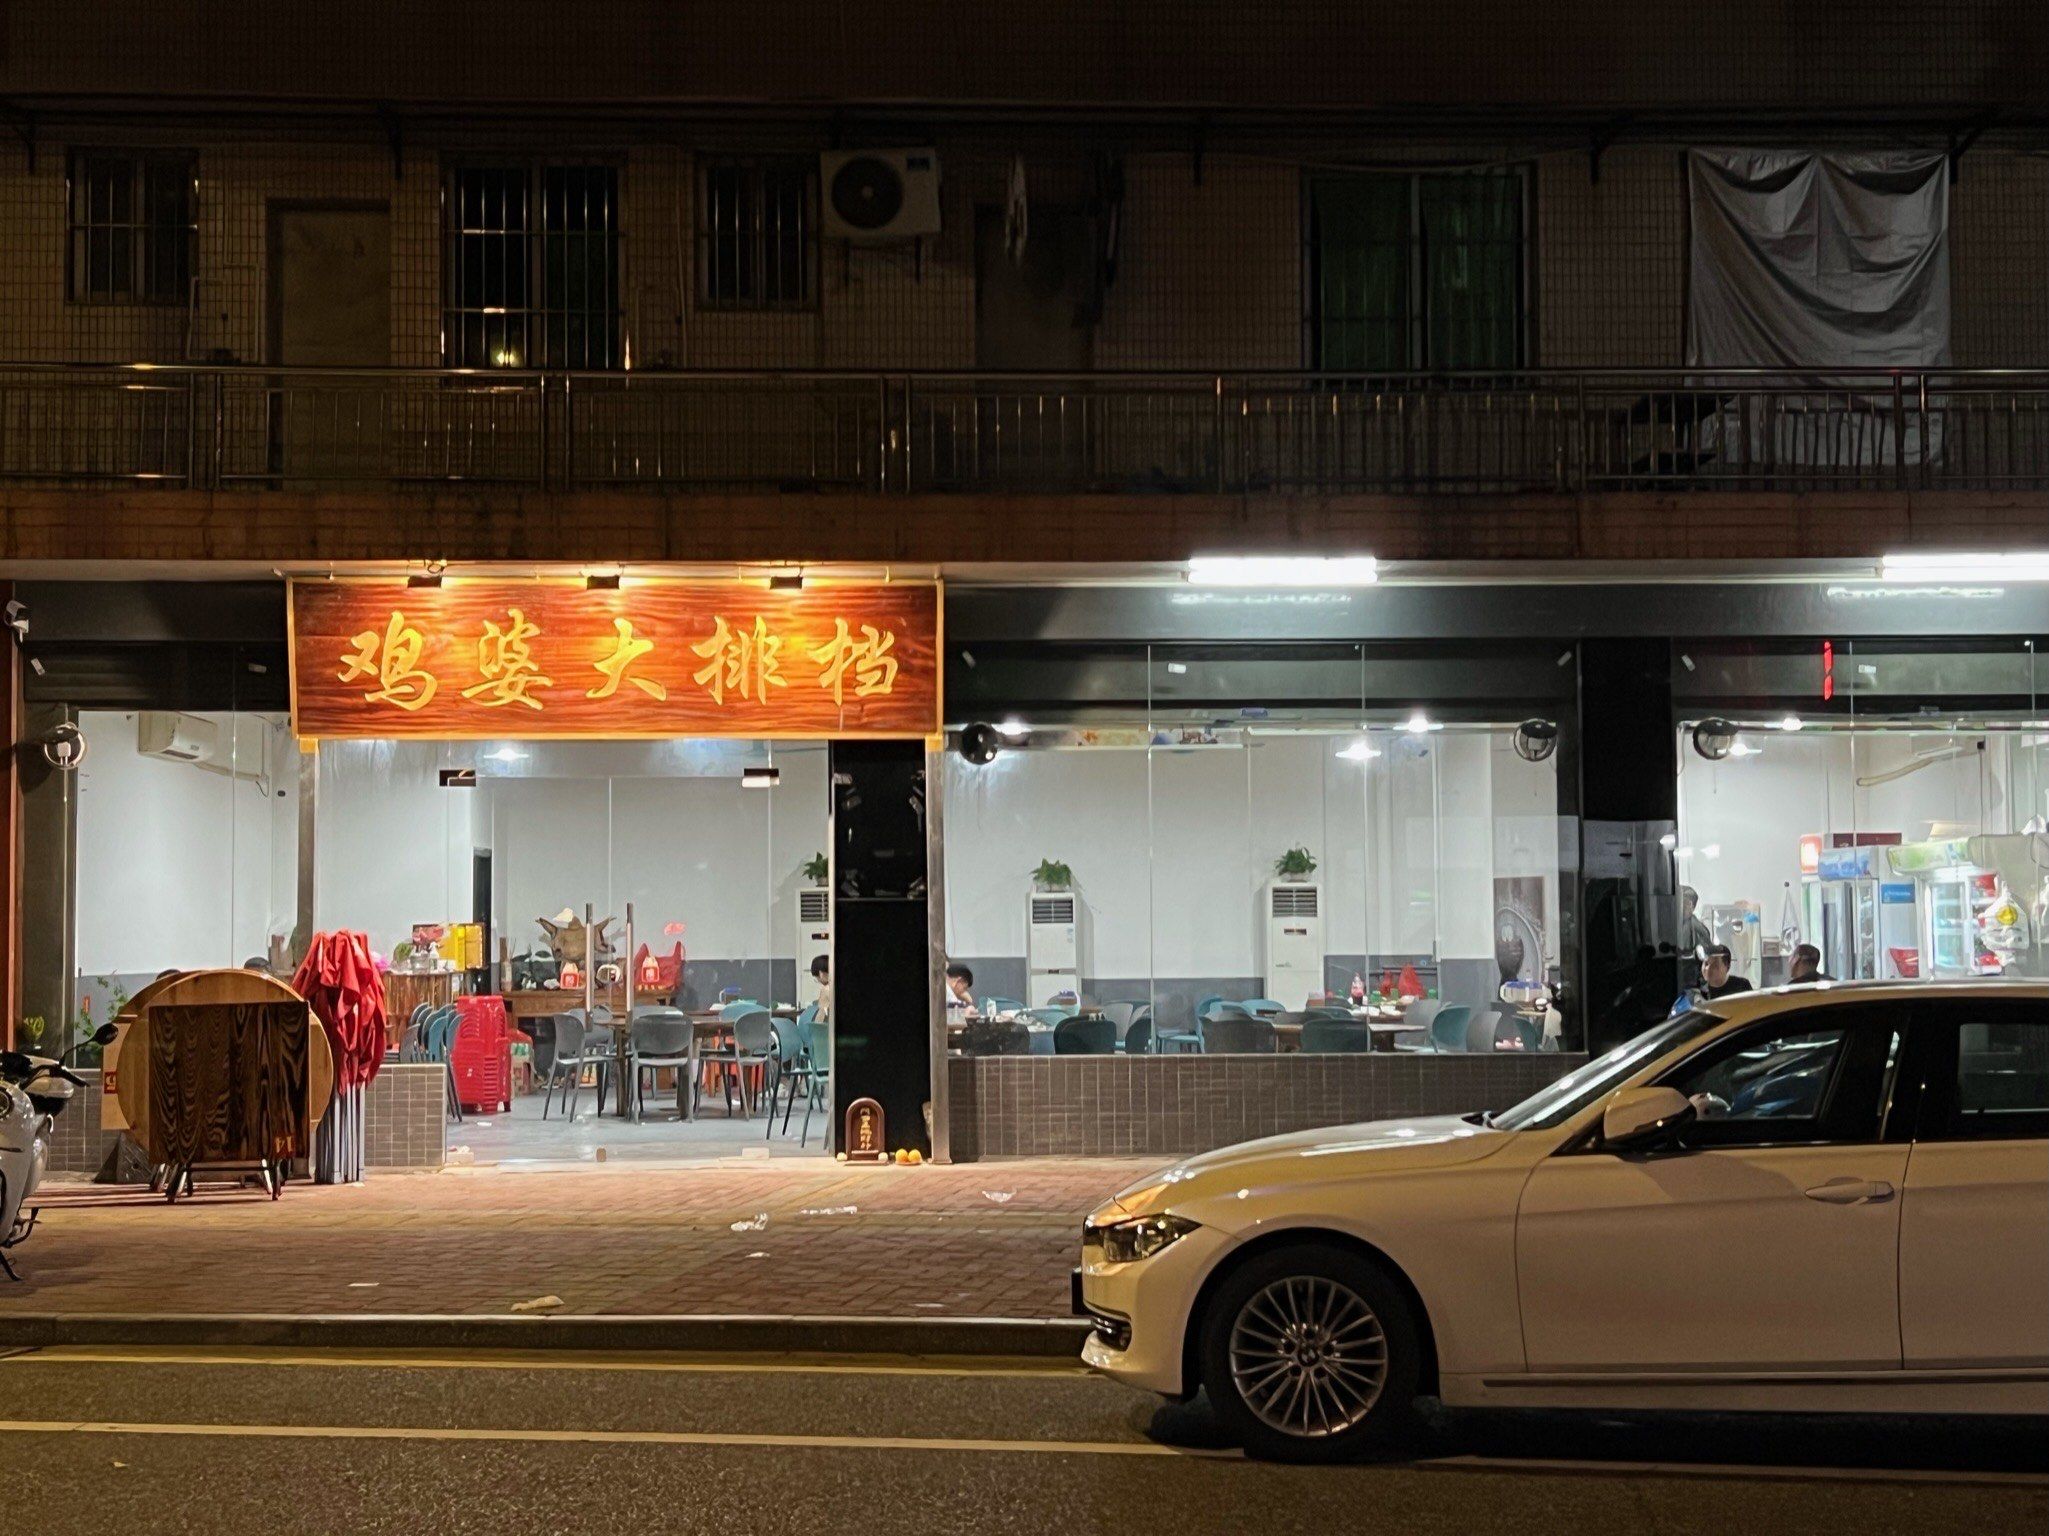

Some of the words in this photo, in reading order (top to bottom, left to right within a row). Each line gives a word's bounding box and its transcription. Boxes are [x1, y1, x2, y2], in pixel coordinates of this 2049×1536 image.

[337, 608, 899, 711] 鸡婆大排档
